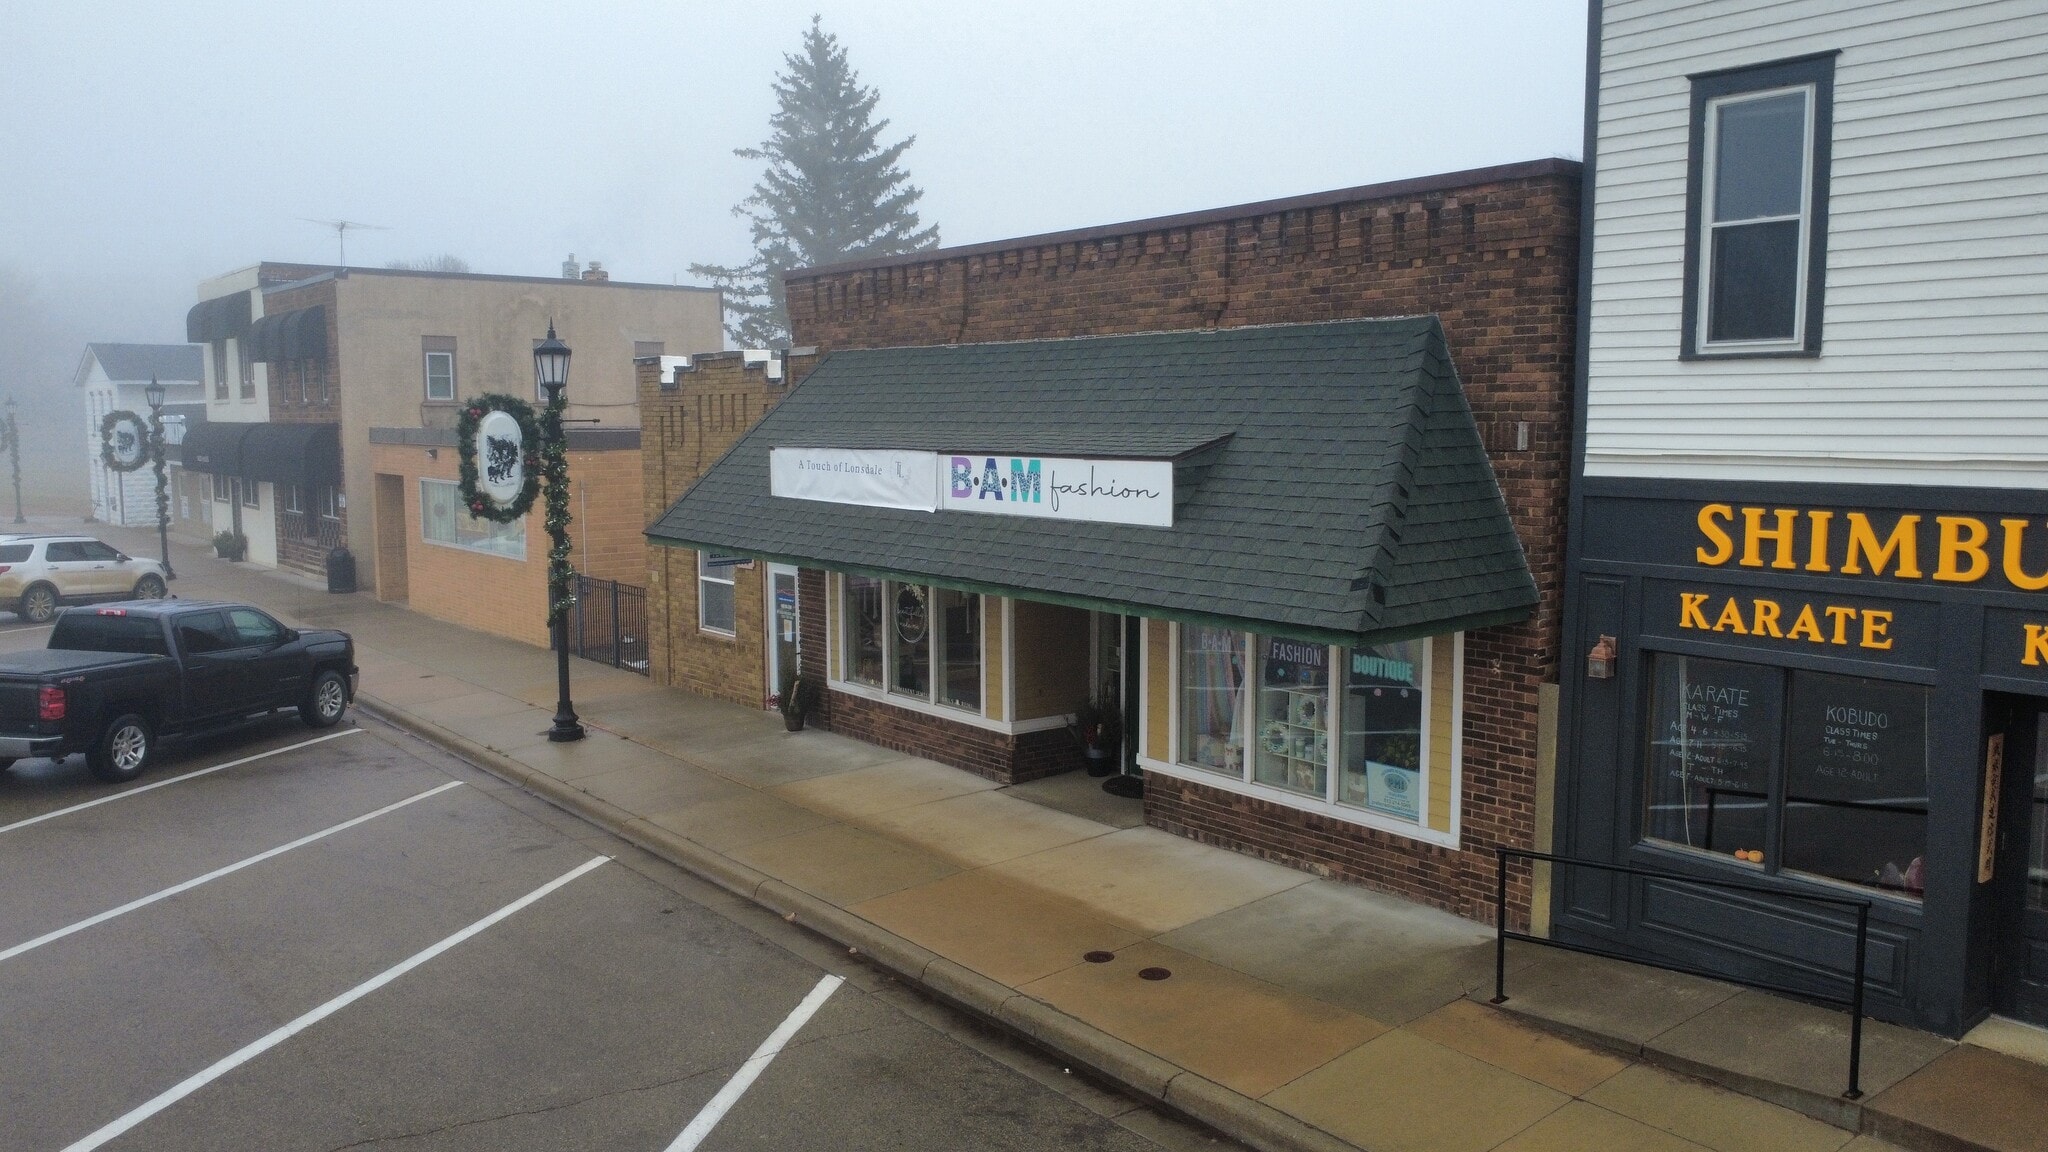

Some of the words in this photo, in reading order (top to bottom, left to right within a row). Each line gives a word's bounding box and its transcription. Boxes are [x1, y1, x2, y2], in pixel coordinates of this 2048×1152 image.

[798, 459, 804, 470] A
[807, 460, 831, 472] Touch
[833, 462, 843, 472] of
[844, 462, 883, 476] Lonsdale
[1049, 464, 1160, 512] fashion
[1679, 592, 1894, 650] KARATE
[1272, 642, 1321, 667] FASHION
[1352, 654, 1414, 683] BOUTIQUE
[1684, 684, 1750, 707] KARATE
[1713, 705, 1739, 719] TIMES
[1826, 705, 1888, 729] KOBUDO
[1825, 725, 1850, 737] CLASS
[1852, 728, 1878, 741] TIMES
[1816, 764, 1834, 776] AGE
